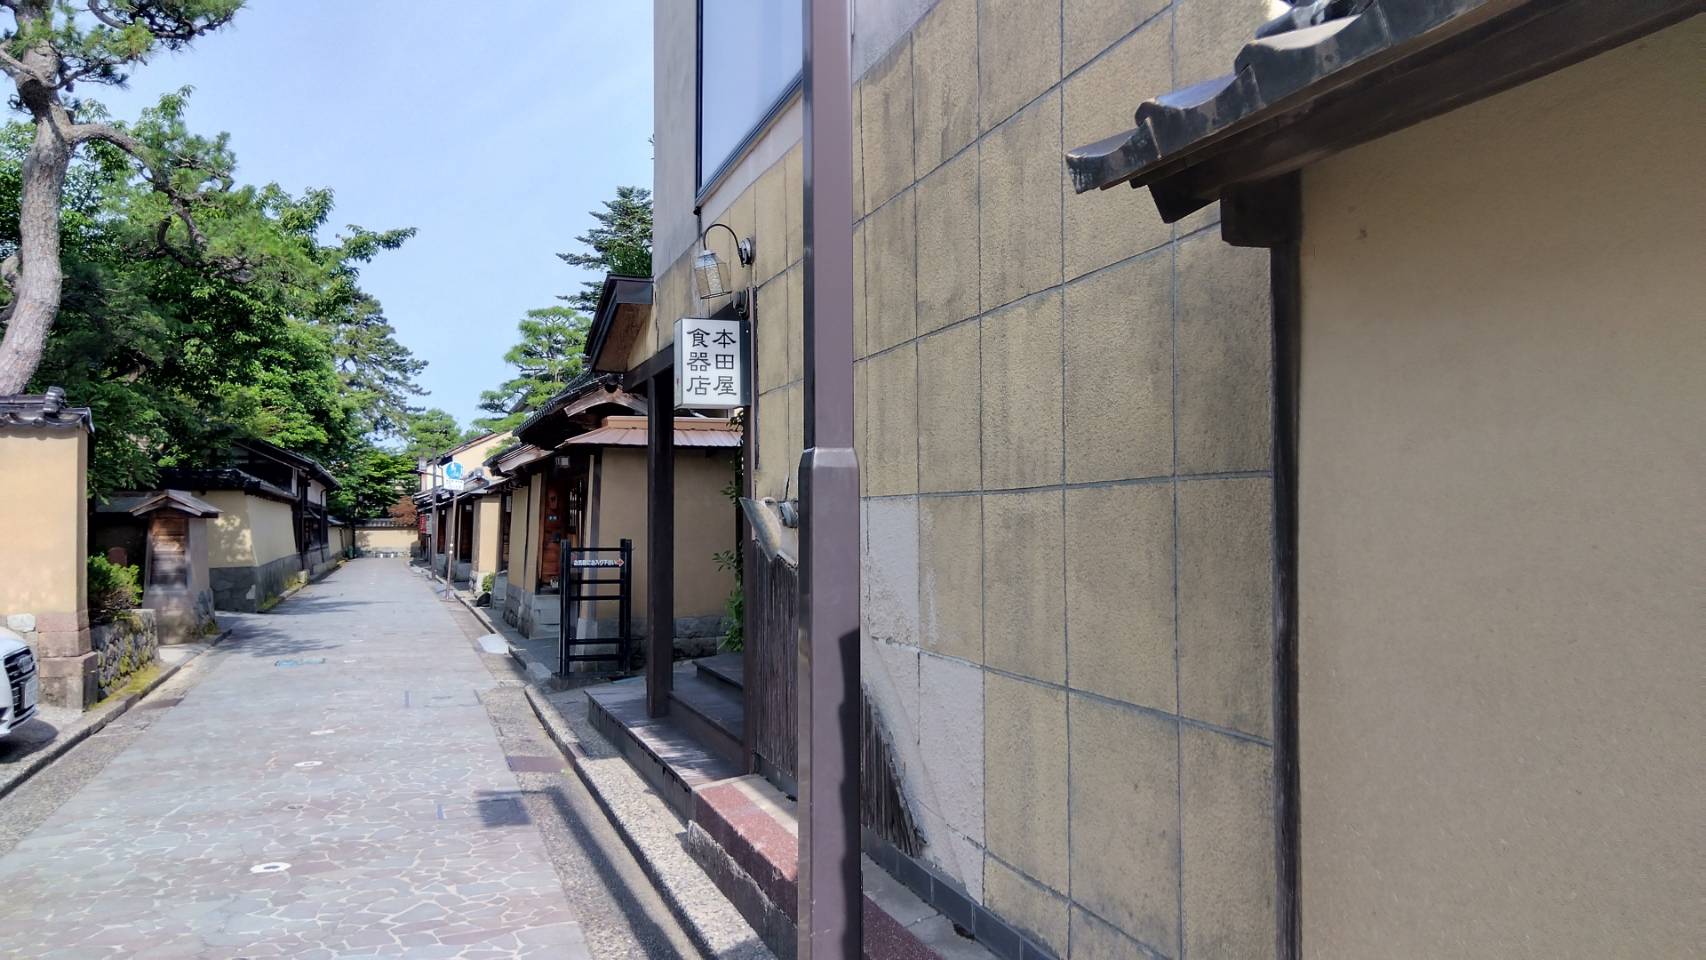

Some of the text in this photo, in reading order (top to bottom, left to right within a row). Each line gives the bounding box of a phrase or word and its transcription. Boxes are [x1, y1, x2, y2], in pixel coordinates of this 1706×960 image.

[686, 327, 711, 396] 食器店
[712, 328, 737, 396] 本田屋
